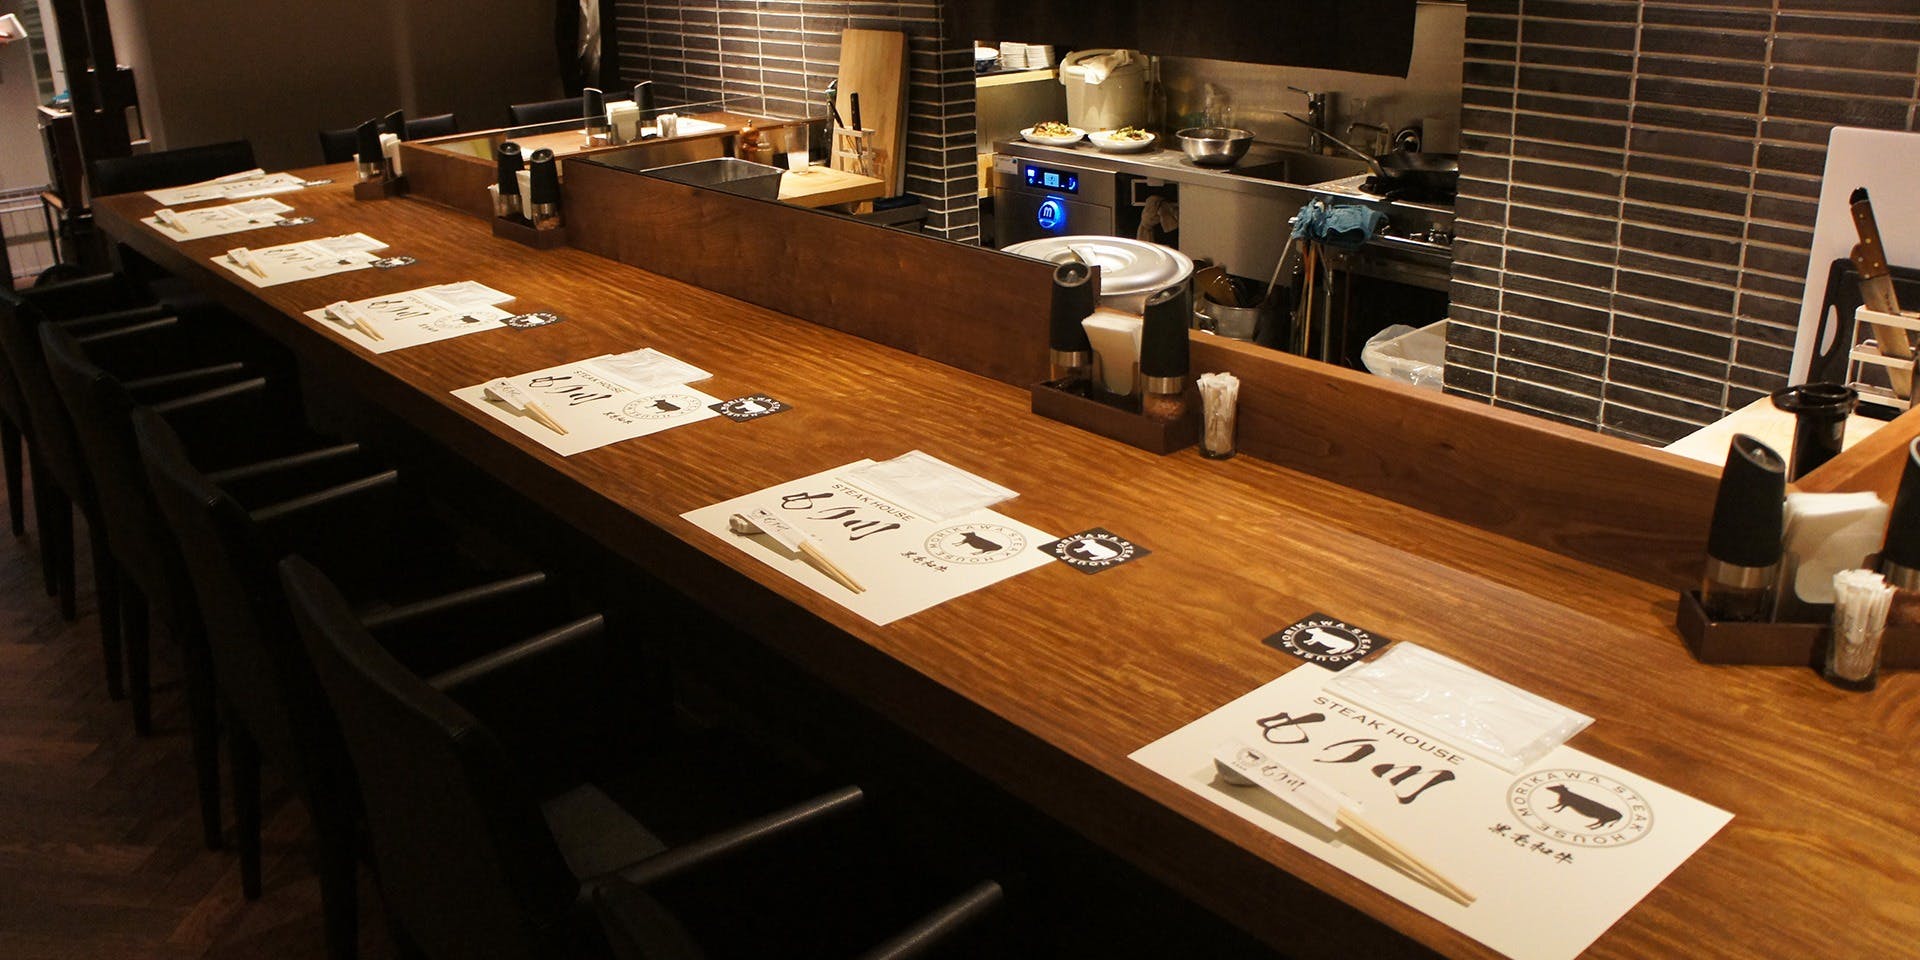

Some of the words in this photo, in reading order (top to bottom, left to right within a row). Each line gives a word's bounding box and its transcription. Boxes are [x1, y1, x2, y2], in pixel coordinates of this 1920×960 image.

[832, 483, 870, 503] STEAK
[871, 500, 915, 522] HOUSE
[1281, 620, 1345, 648] MORIKAWA
[1351, 628, 1372, 655] STEAK
[1293, 648, 1353, 662] HOUSE
[1312, 696, 1385, 730] STEAK
[1386, 727, 1466, 766] HOUSE
[1513, 771, 1601, 818] MORIKAWA
[1613, 785, 1648, 832] STEAK
[1536, 822, 1627, 845] HOUSE
